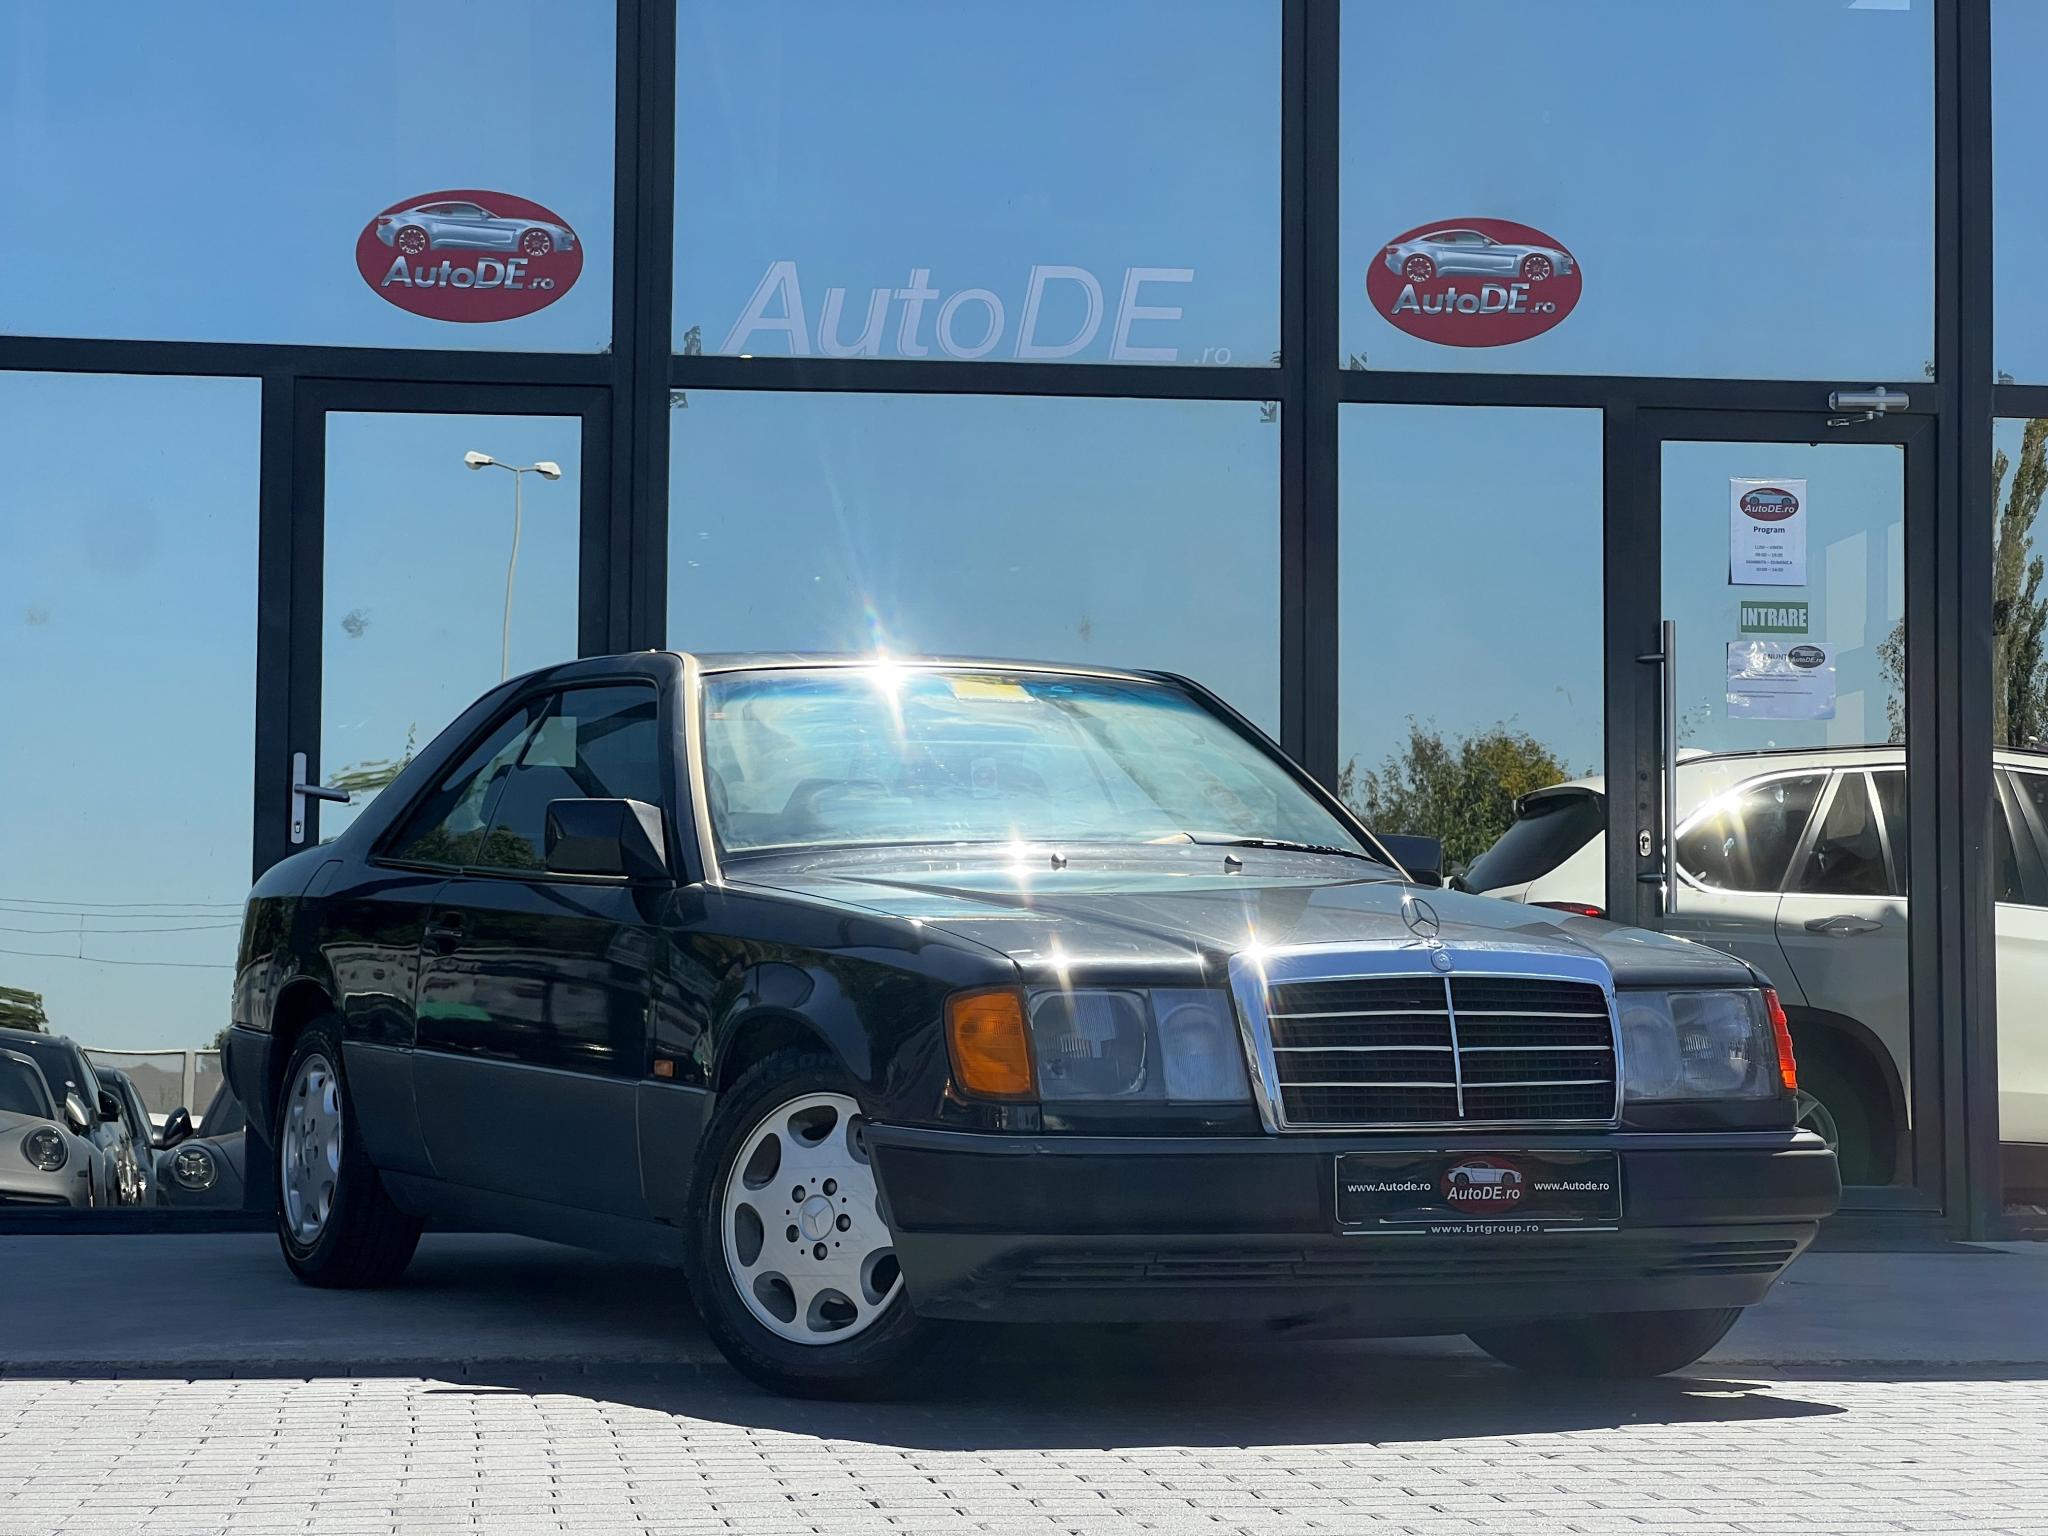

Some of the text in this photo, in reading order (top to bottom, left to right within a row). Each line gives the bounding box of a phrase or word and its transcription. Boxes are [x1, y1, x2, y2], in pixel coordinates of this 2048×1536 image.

[380, 255, 555, 290] AutoDE.ro
[1391, 283, 1556, 315] AutoDE.ro
[1744, 504, 1795, 514] AutoDE.ro
[1753, 526, 1786, 535] Program
[1742, 608, 1807, 627] INTRARE
[1347, 1181, 1431, 1193] www.Autode.ro
[1534, 1180, 1610, 1192] www.Autode.ro
[1447, 1186, 1521, 1200] AutoDE.ro
[1431, 1223, 1539, 1235] www.brtgroup.ro
